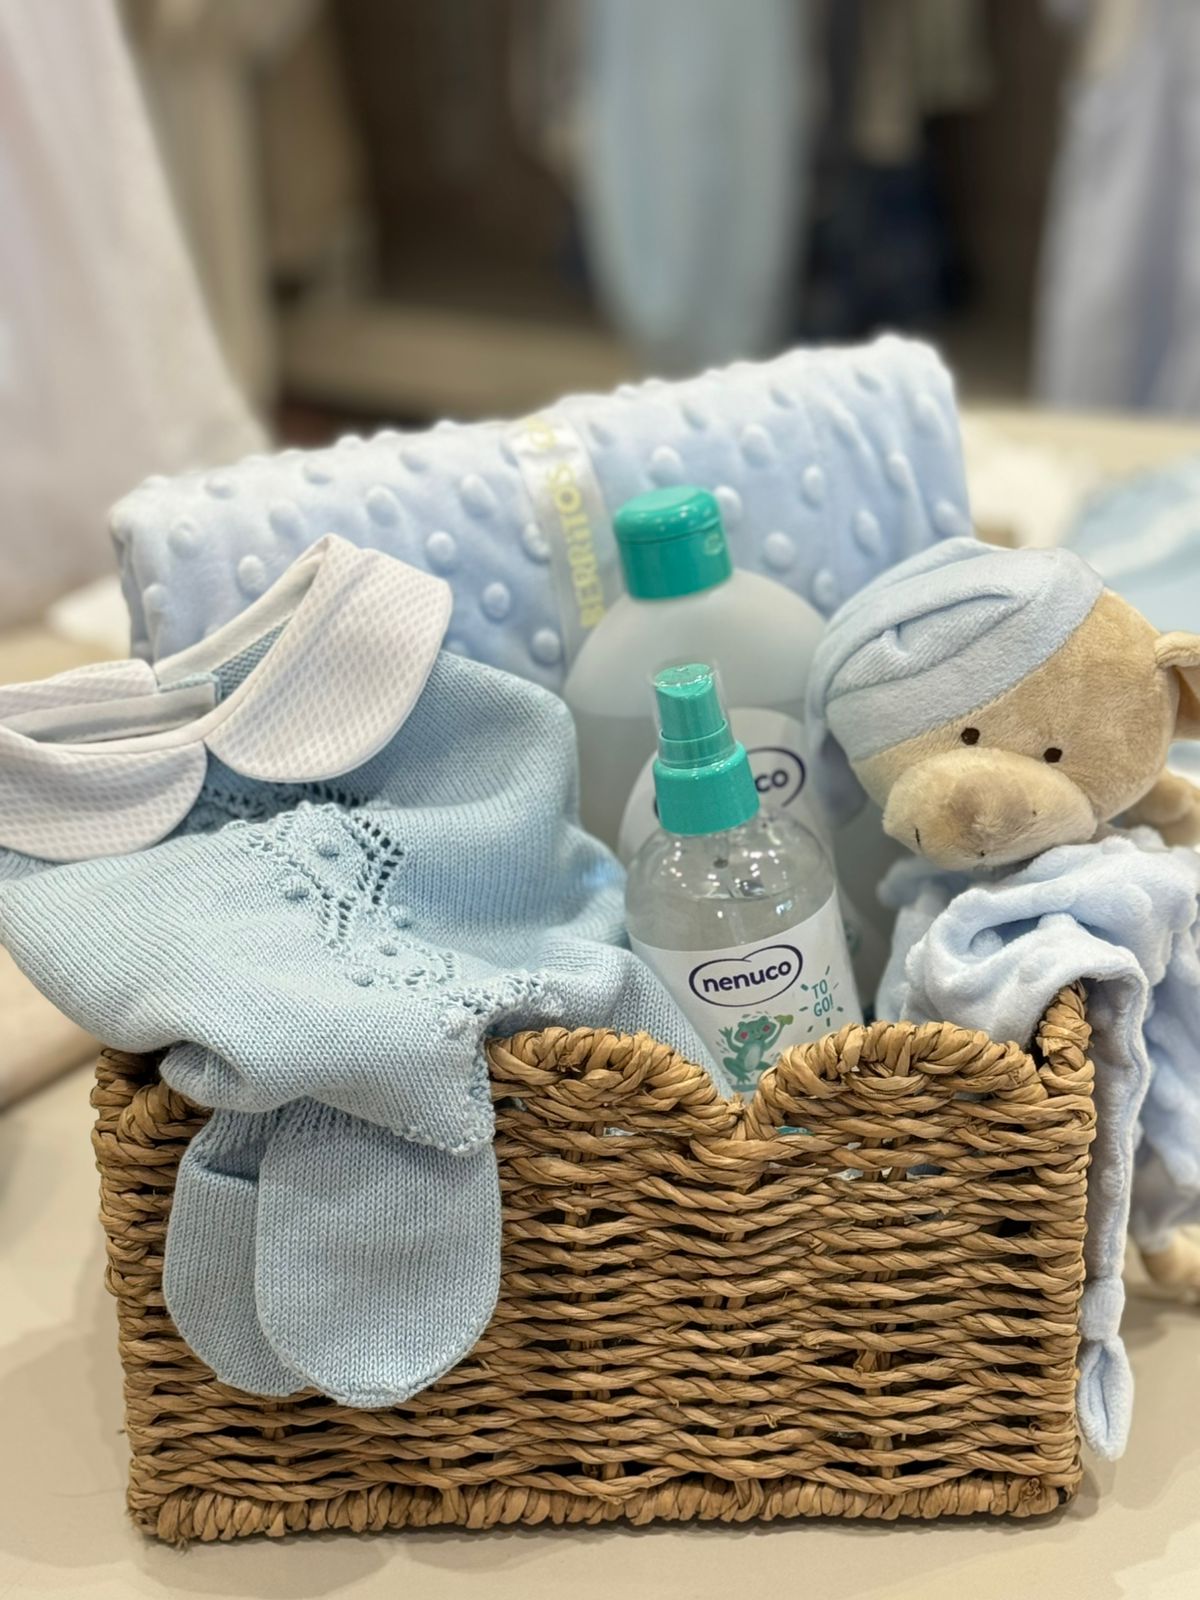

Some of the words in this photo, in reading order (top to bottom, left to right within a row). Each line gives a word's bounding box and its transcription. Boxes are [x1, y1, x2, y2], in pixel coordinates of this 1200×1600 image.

[702, 961, 792, 993] nenuco
[811, 979, 828, 999] TO
[813, 993, 834, 1017] GO!
